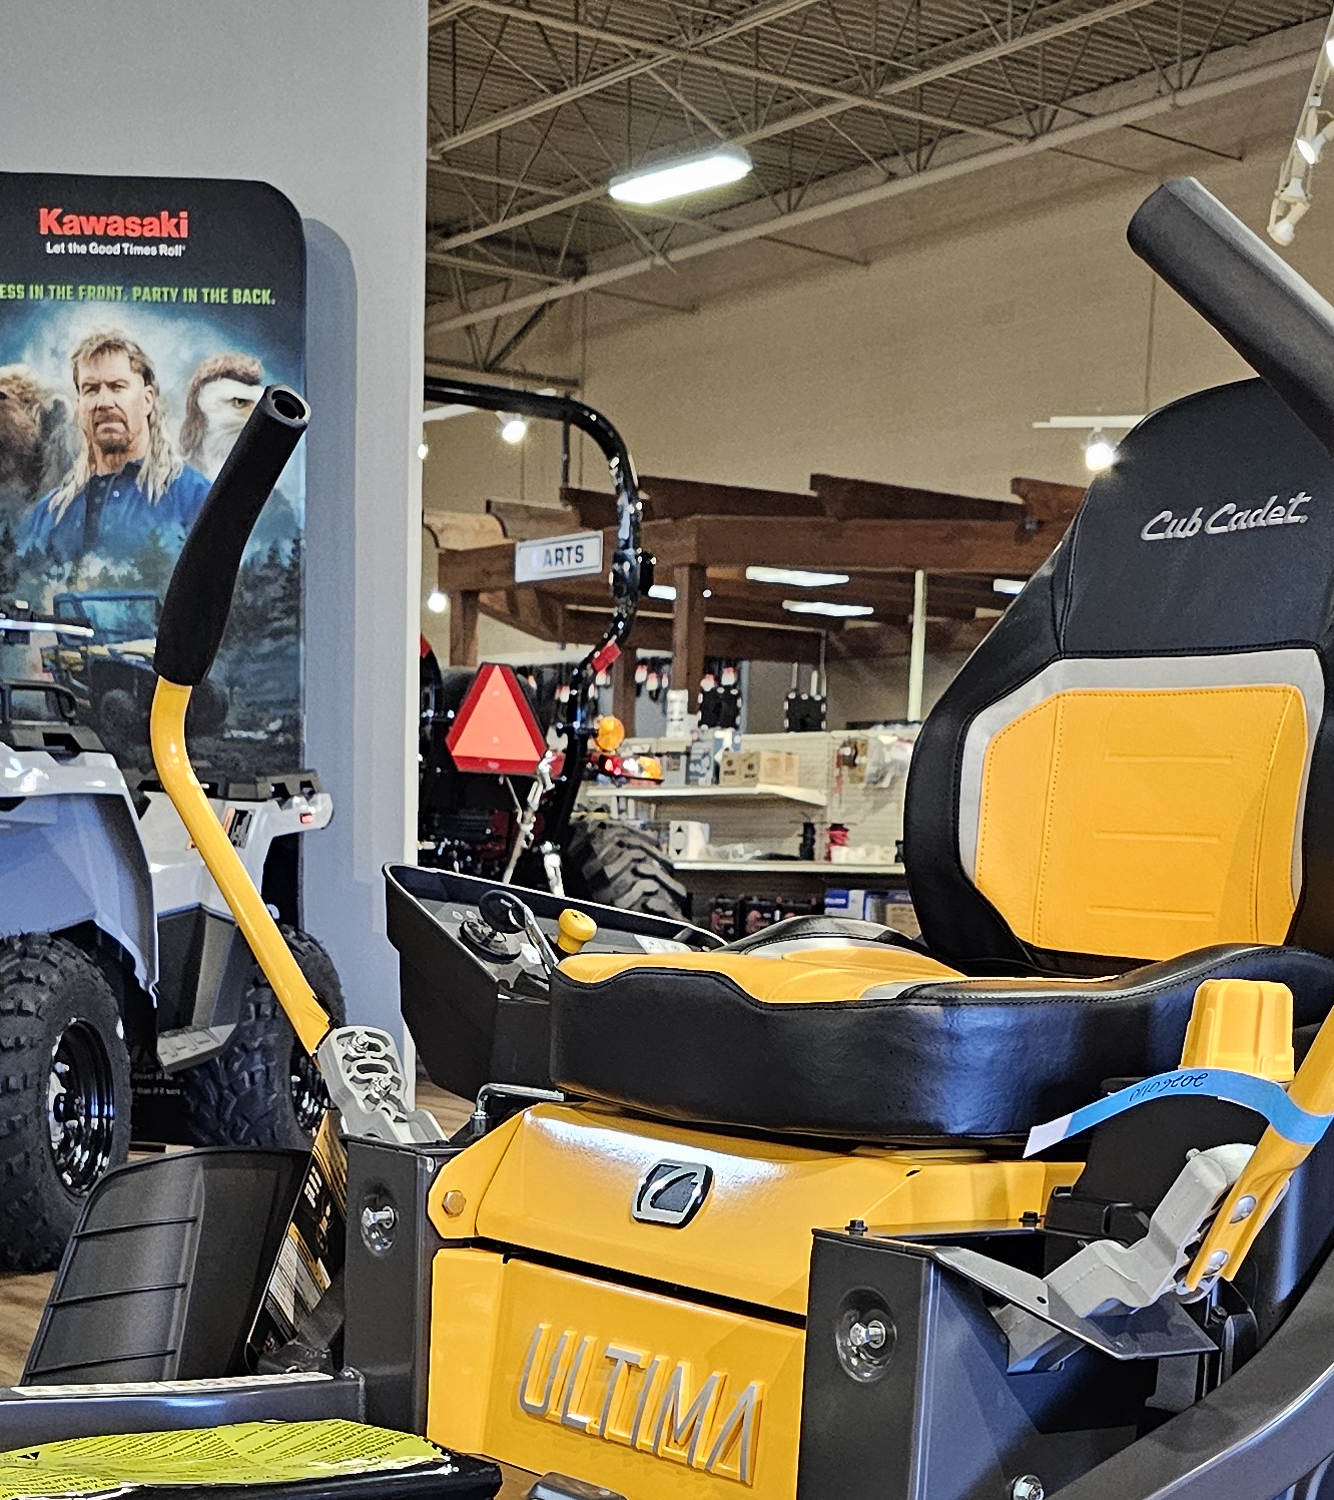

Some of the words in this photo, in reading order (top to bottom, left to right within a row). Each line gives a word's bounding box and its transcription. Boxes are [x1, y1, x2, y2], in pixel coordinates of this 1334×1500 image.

[38, 207, 189, 239] Kawasaki
[45, 241, 66, 255] Let
[68, 241, 88, 255] the
[88, 241, 120, 256] Good
[121, 242, 158, 257] Times
[158, 244, 183, 258] Roll
[29, 284, 44, 300] IN
[47, 284, 75, 301] THE
[132, 286, 179, 303] PARTY
[182, 287, 198, 304] IN
[201, 287, 229, 305] THE
[232, 288, 276, 306] BACK.
[1140, 507, 1204, 541] Cub
[1204, 491, 1313, 535] Cadet
[518, 1322, 765, 1489] ULTIMA
